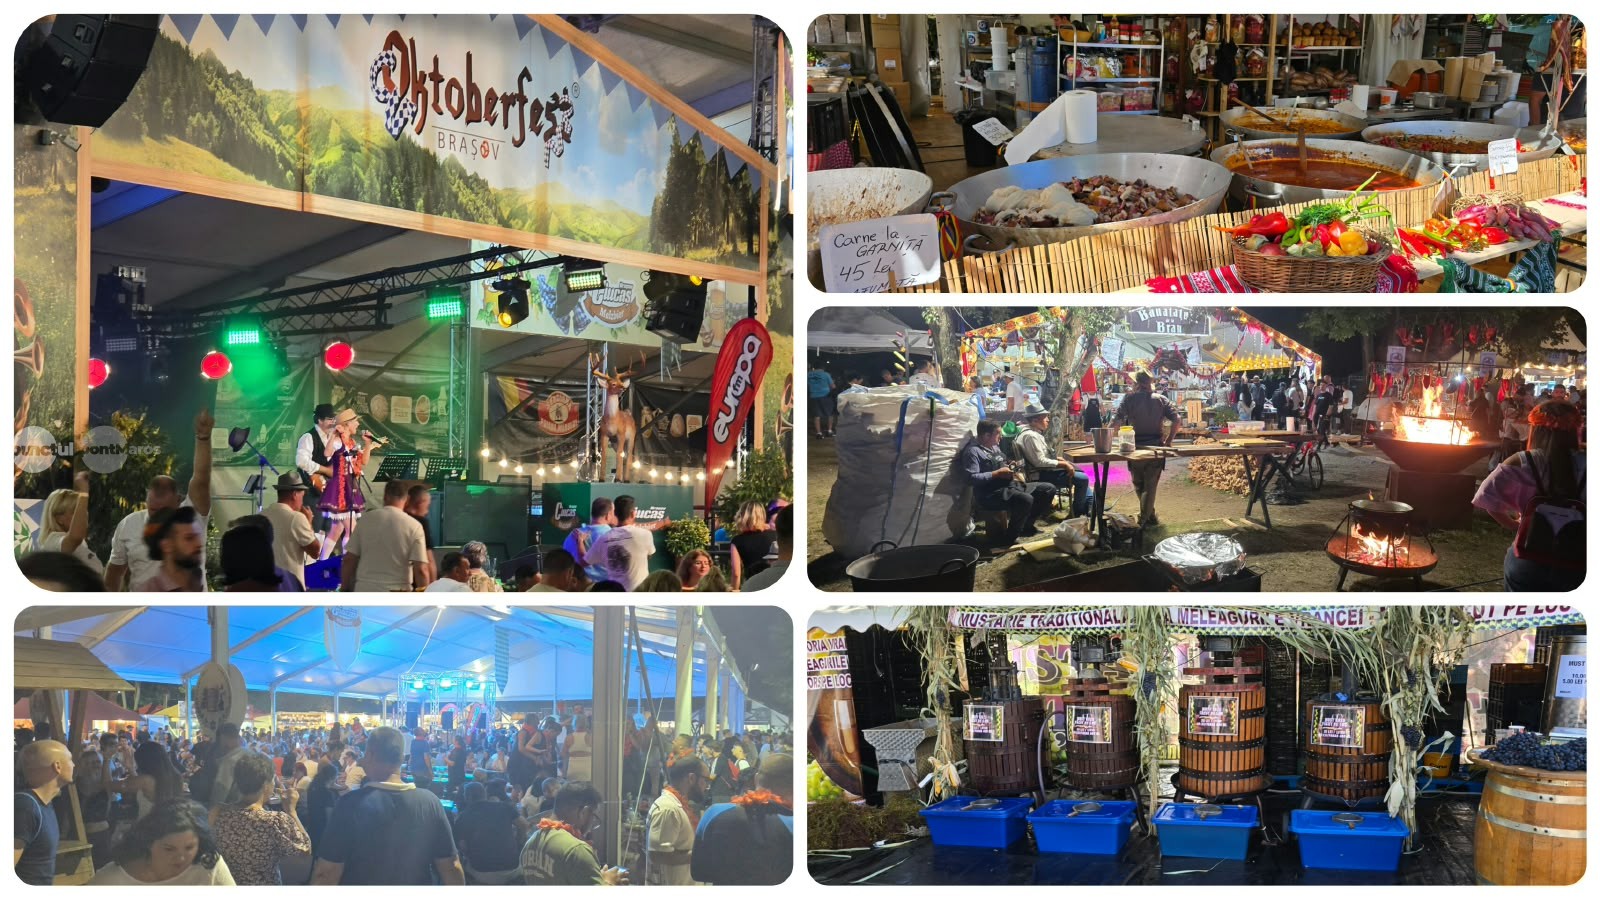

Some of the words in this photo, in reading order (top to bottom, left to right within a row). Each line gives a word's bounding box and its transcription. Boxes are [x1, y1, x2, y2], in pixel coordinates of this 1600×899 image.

[369, 30, 574, 168] Oktoberfest
[833, 233, 877, 249] Carne
[886, 225, 900, 241] la
[839, 260, 871, 283] 45
[713, 334, 762, 443] europa
